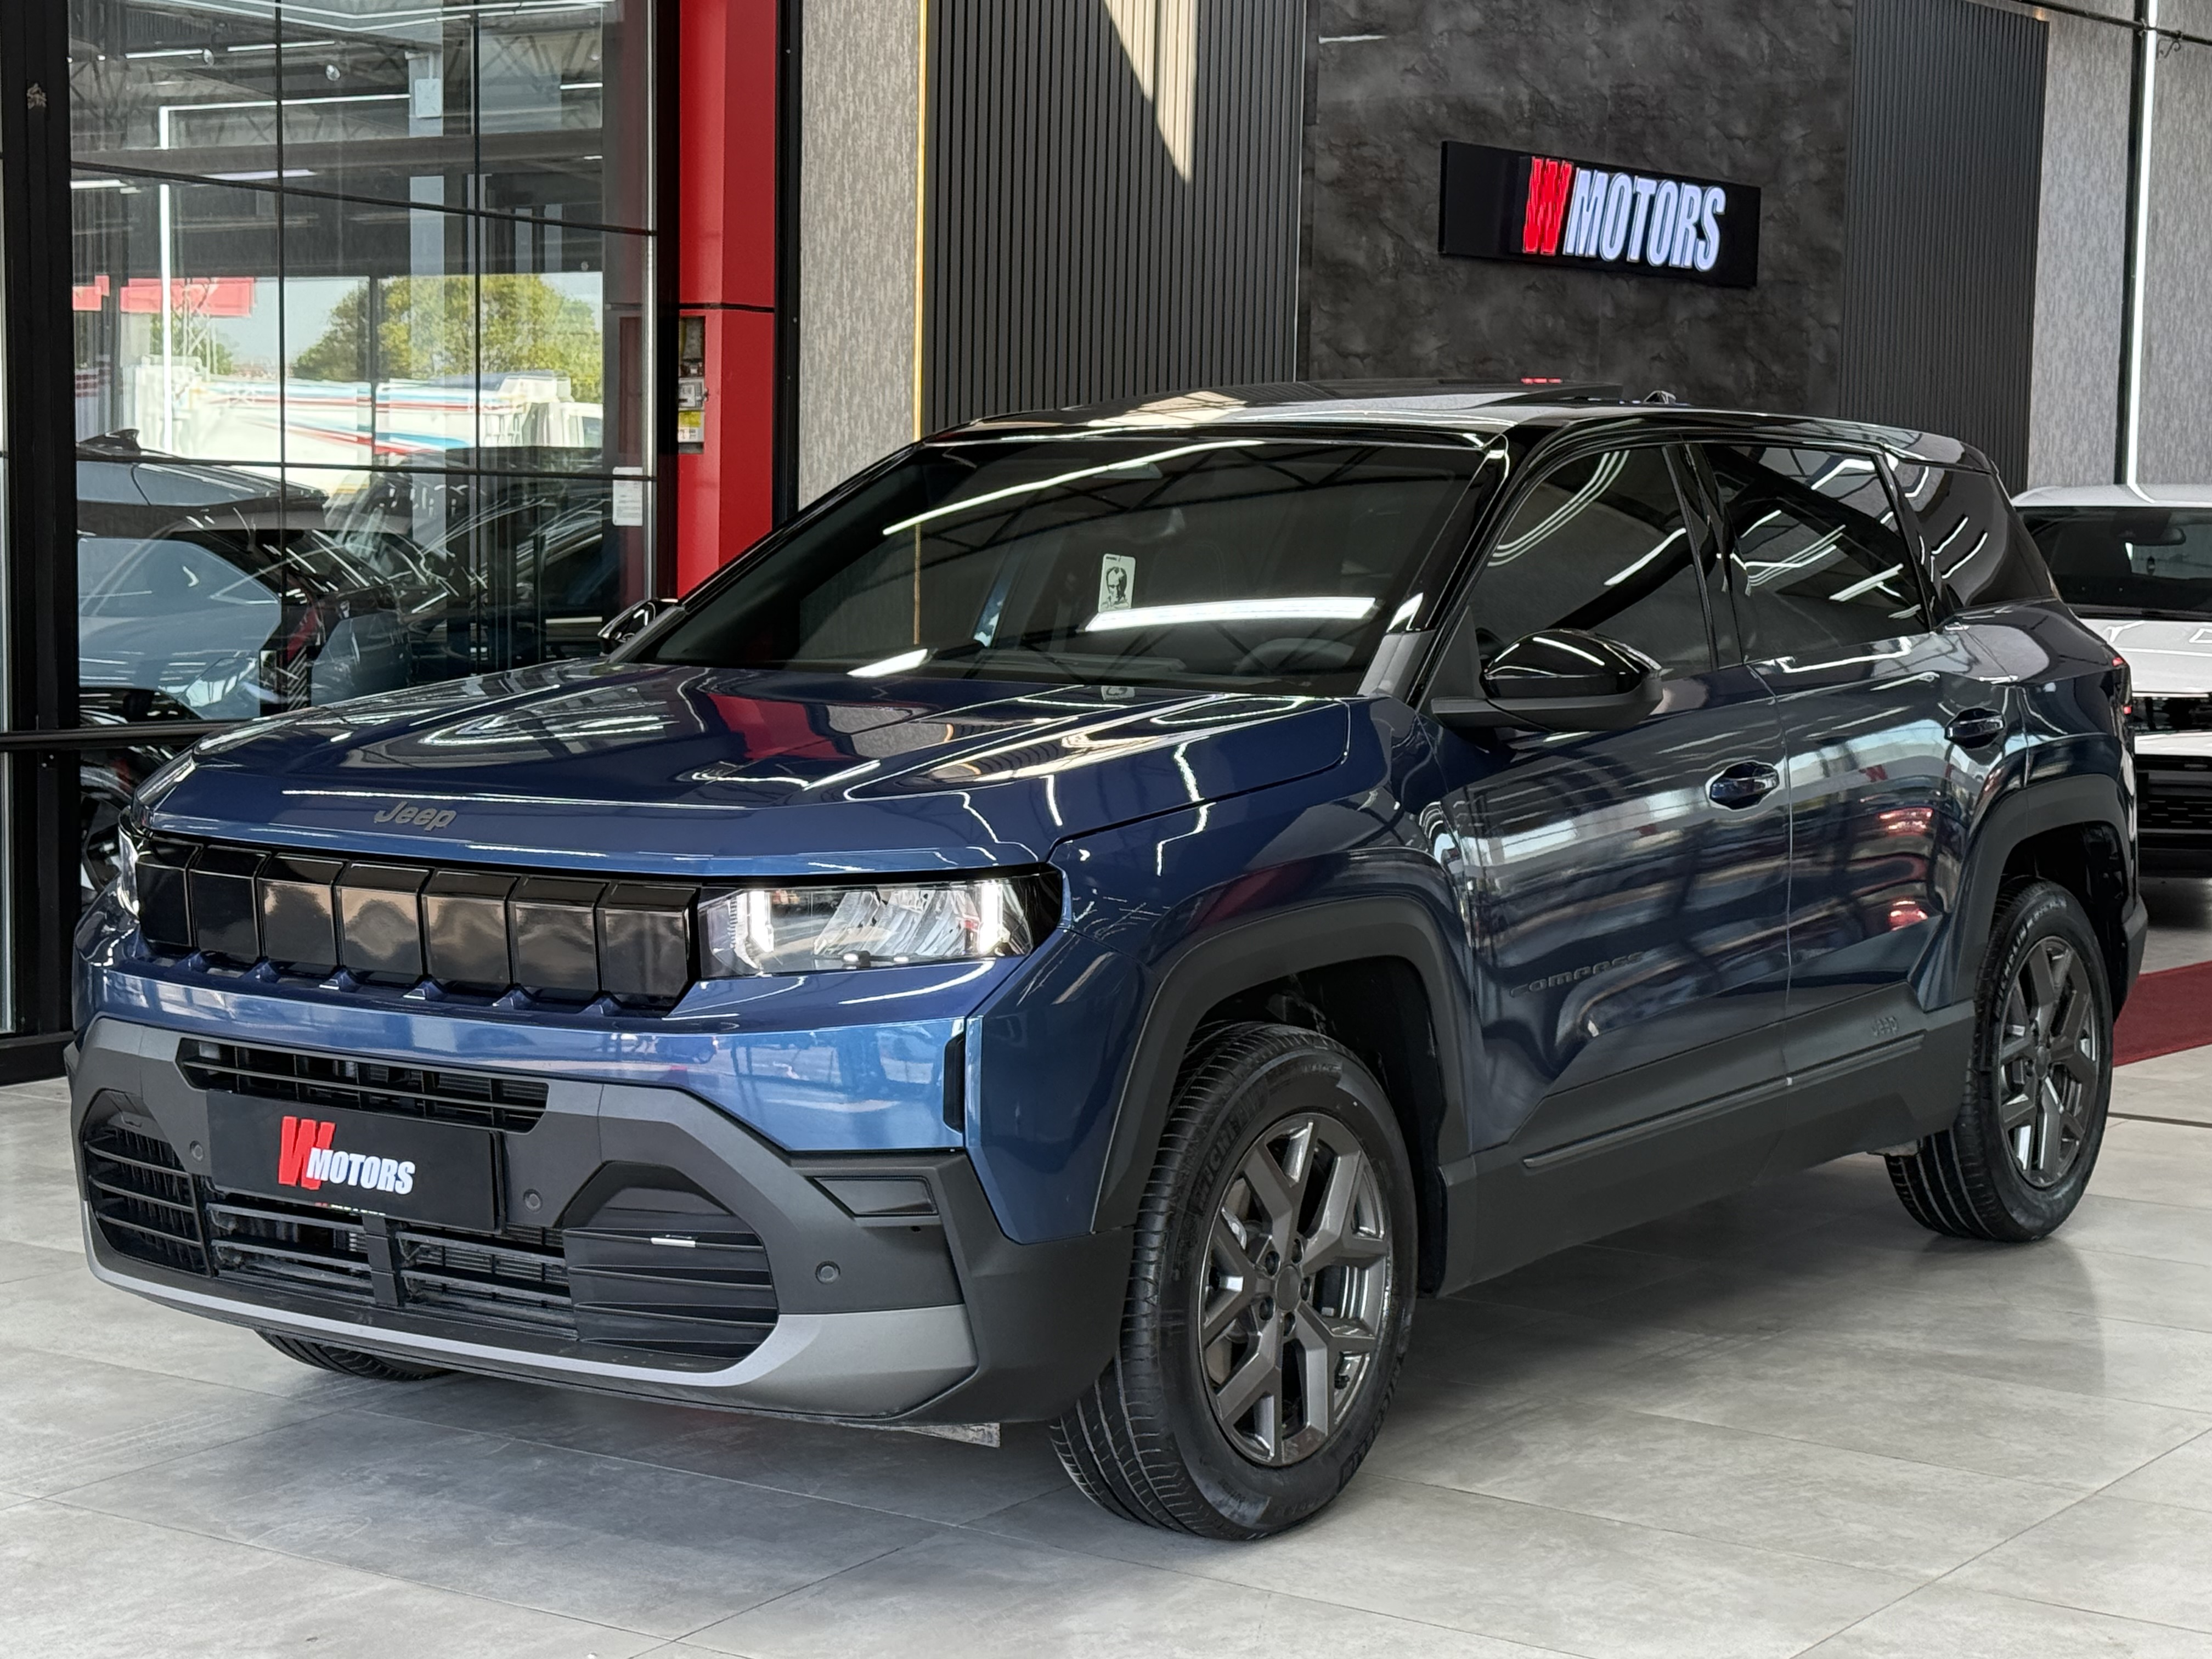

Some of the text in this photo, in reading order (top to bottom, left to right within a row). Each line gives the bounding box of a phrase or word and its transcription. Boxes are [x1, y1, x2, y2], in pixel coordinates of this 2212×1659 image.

[1563, 167, 1726, 272] MOTORS
[374, 800, 457, 832] Jeep
[305, 1147, 416, 1195] MOTORS
